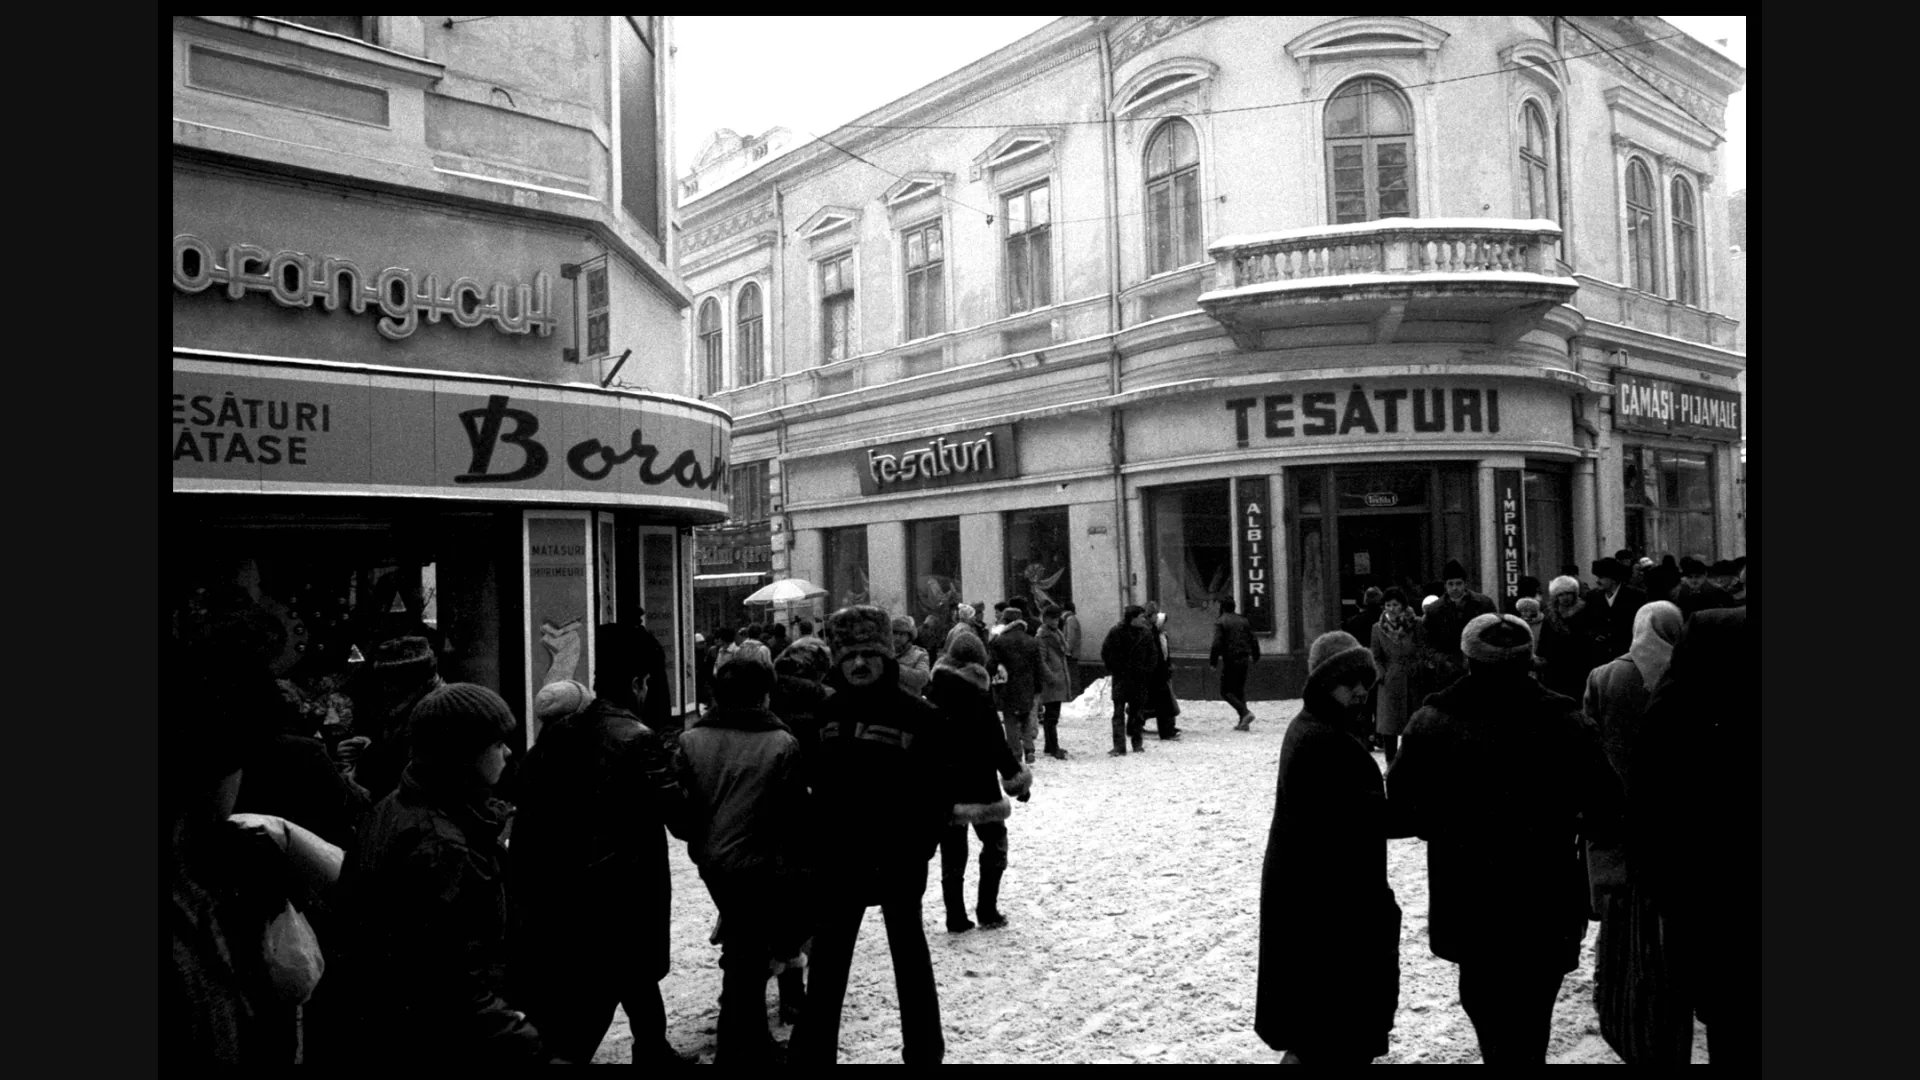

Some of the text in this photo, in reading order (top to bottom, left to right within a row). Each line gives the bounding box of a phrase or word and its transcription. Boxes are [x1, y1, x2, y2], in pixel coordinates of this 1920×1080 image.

[173, 234, 556, 340] orangicul
[173, 391, 330, 432] ESĂTURI
[173, 427, 307, 465] ĂTASE
[454, 394, 730, 494] Boran
[1246, 502, 1265, 607] ALBITURI
[1503, 487, 1518, 597] IMPRIMEUR
